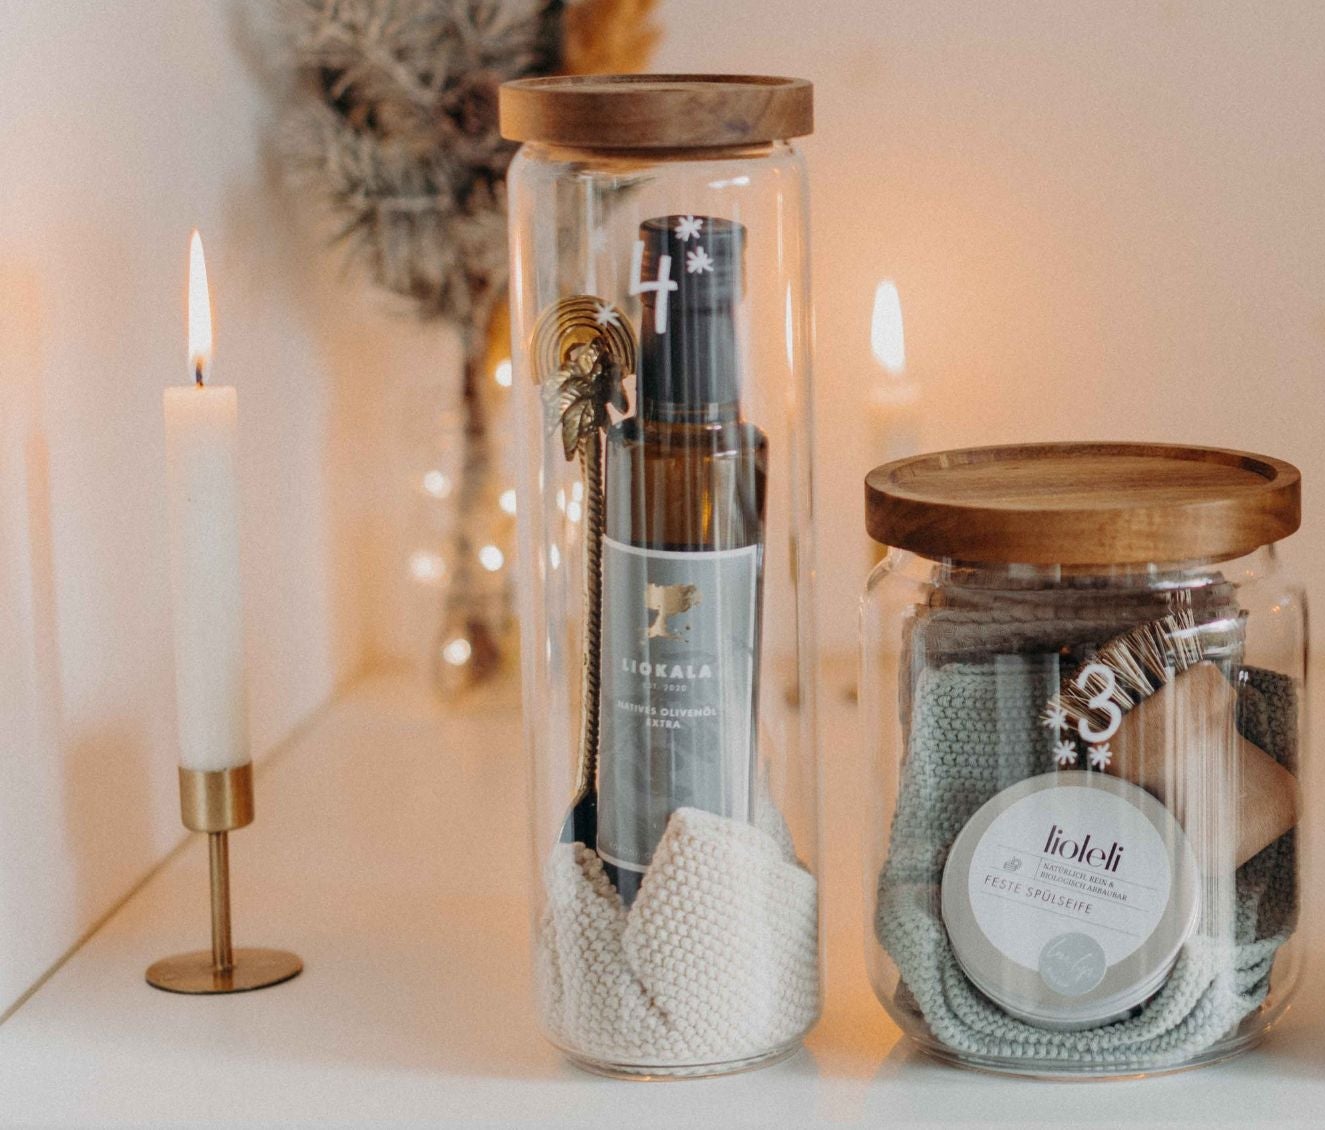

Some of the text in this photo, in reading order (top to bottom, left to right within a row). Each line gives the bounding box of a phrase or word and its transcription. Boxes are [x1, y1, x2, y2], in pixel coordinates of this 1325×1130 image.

[628, 240, 678, 334] 4
[622, 658, 712, 679] LIOKALA
[663, 683, 688, 692] 2020
[617, 700, 717, 718] NATIVES OLIVENÖL
[1076, 663, 1122, 743] 3
[646, 718, 680, 729] EXTRA
[1044, 825, 1124, 872] lioleli
[984, 874, 1094, 914] FESTE SPÜLSEIFE
